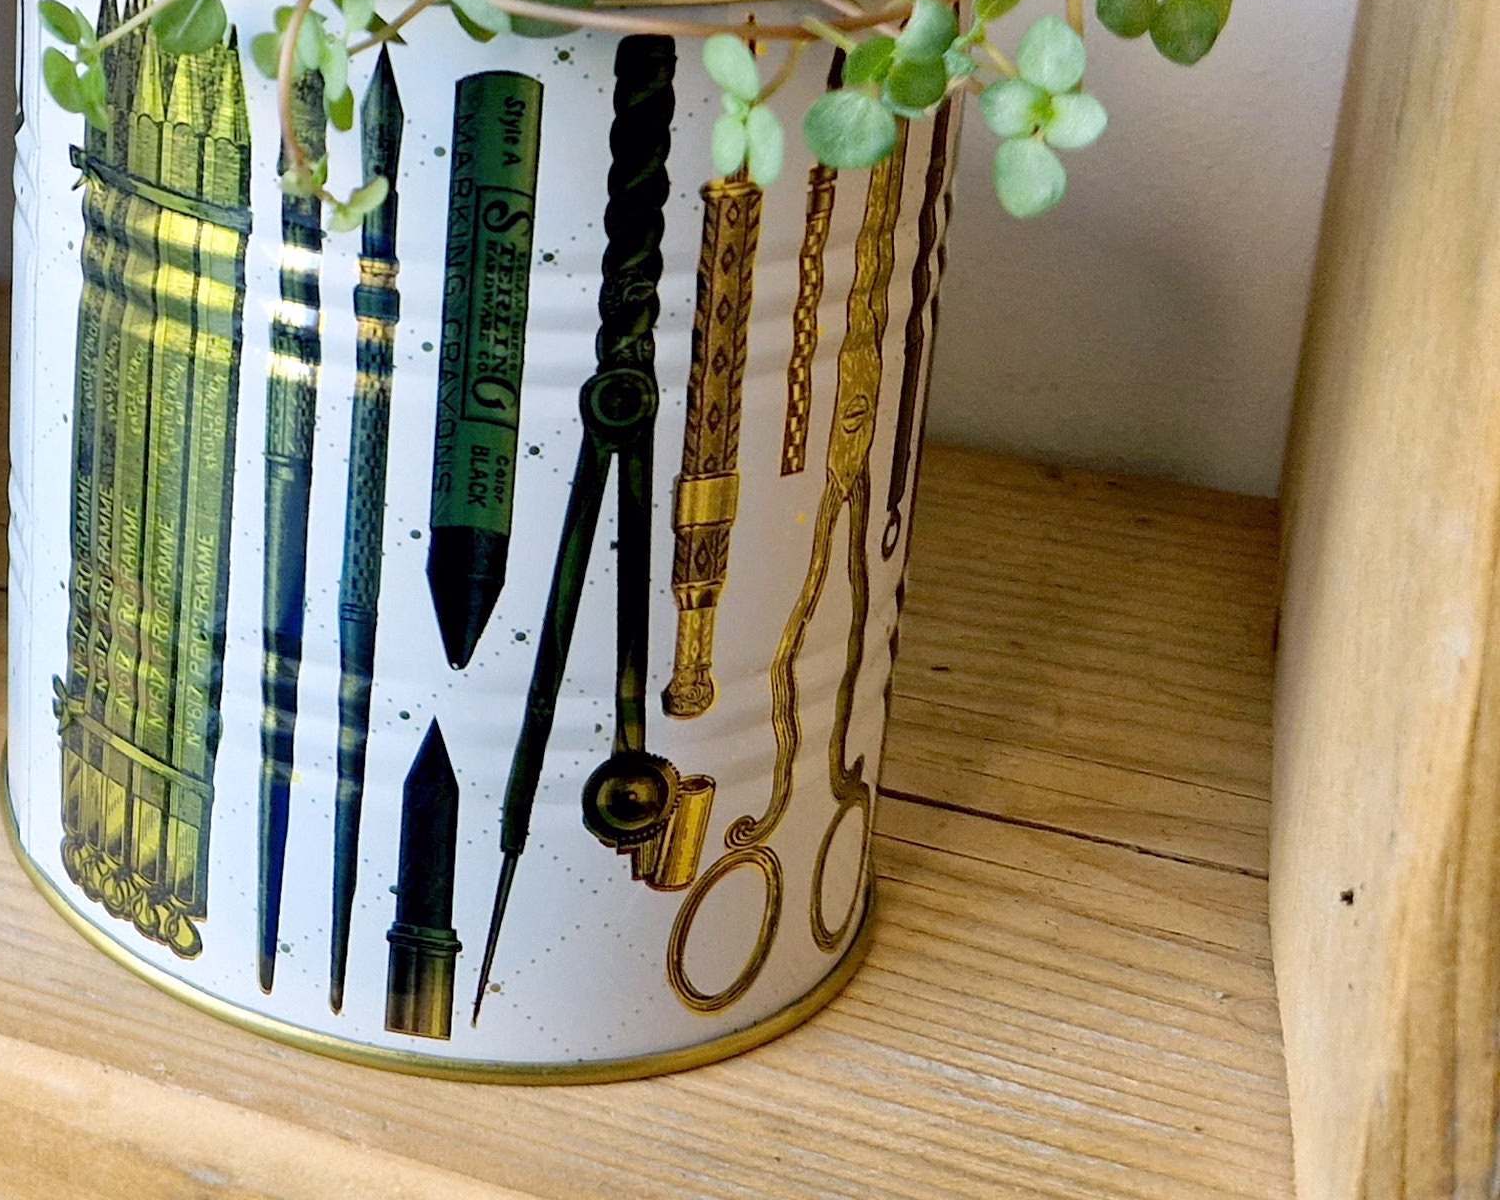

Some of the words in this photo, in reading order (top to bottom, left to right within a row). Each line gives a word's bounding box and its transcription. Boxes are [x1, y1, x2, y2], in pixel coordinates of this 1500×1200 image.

[499, 97, 526, 146] Style
[503, 151, 521, 166] A
[75, 474, 93, 611] PROGRAMME
[468, 445, 490, 508] BLACK
[494, 455, 510, 504] Color
[96, 484, 114, 624] PROGRAMME
[118, 501, 138, 643] PROGRAMME
[151, 517, 174, 660] PROGRAMME
[189, 532, 213, 679] PROGRAMME
